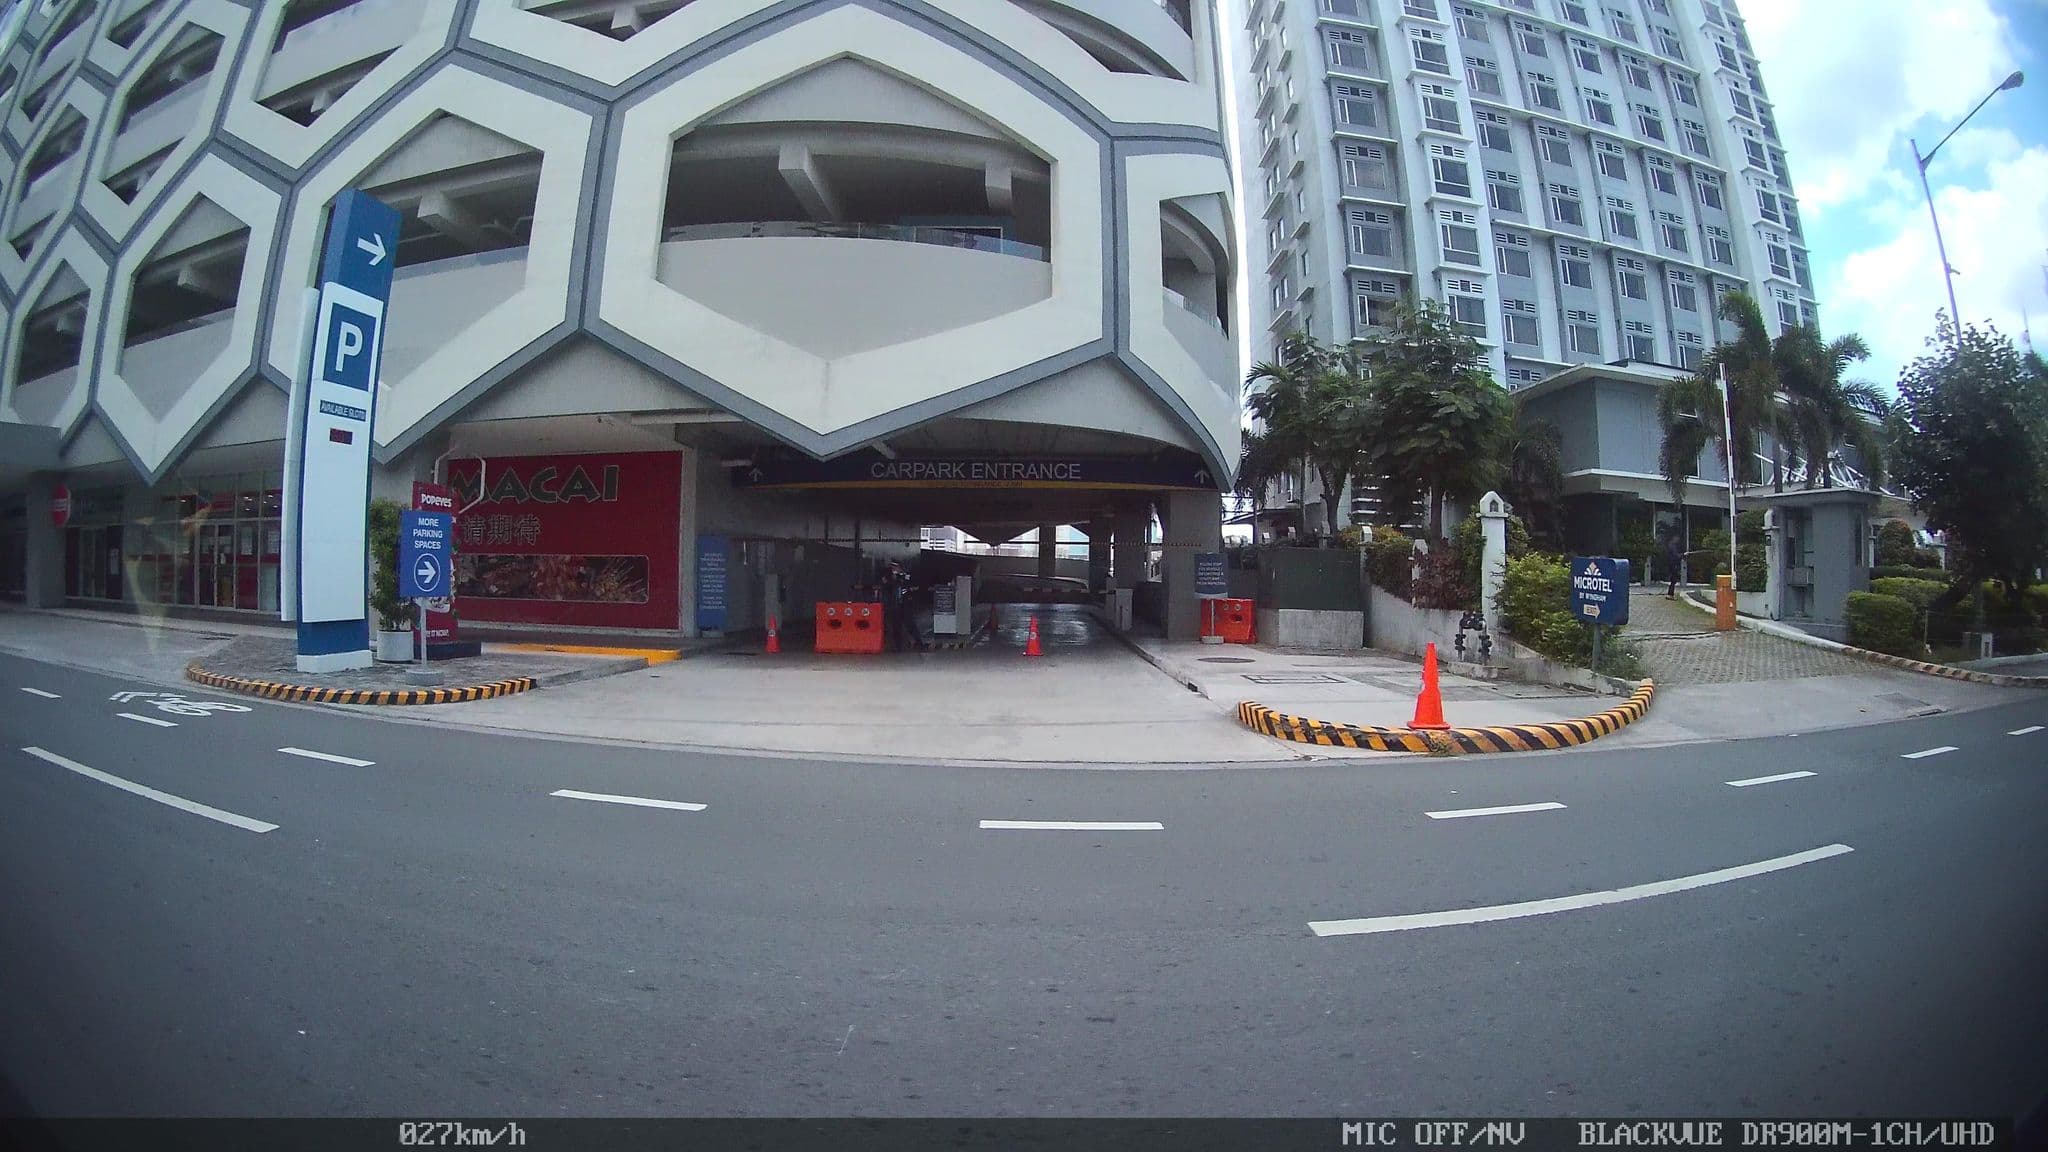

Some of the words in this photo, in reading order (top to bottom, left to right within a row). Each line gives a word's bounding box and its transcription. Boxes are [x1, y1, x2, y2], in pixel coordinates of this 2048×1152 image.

[335, 320, 363, 372] P
[871, 462, 965, 479] CARPARK
[971, 462, 1081, 480] ENTRANCE
[452, 464, 620, 505] MACAI
[418, 517, 439, 527] MORE
[412, 528, 443, 539] PARKING
[414, 540, 442, 550] SPACES
[1574, 576, 1613, 593] MICROTEL
